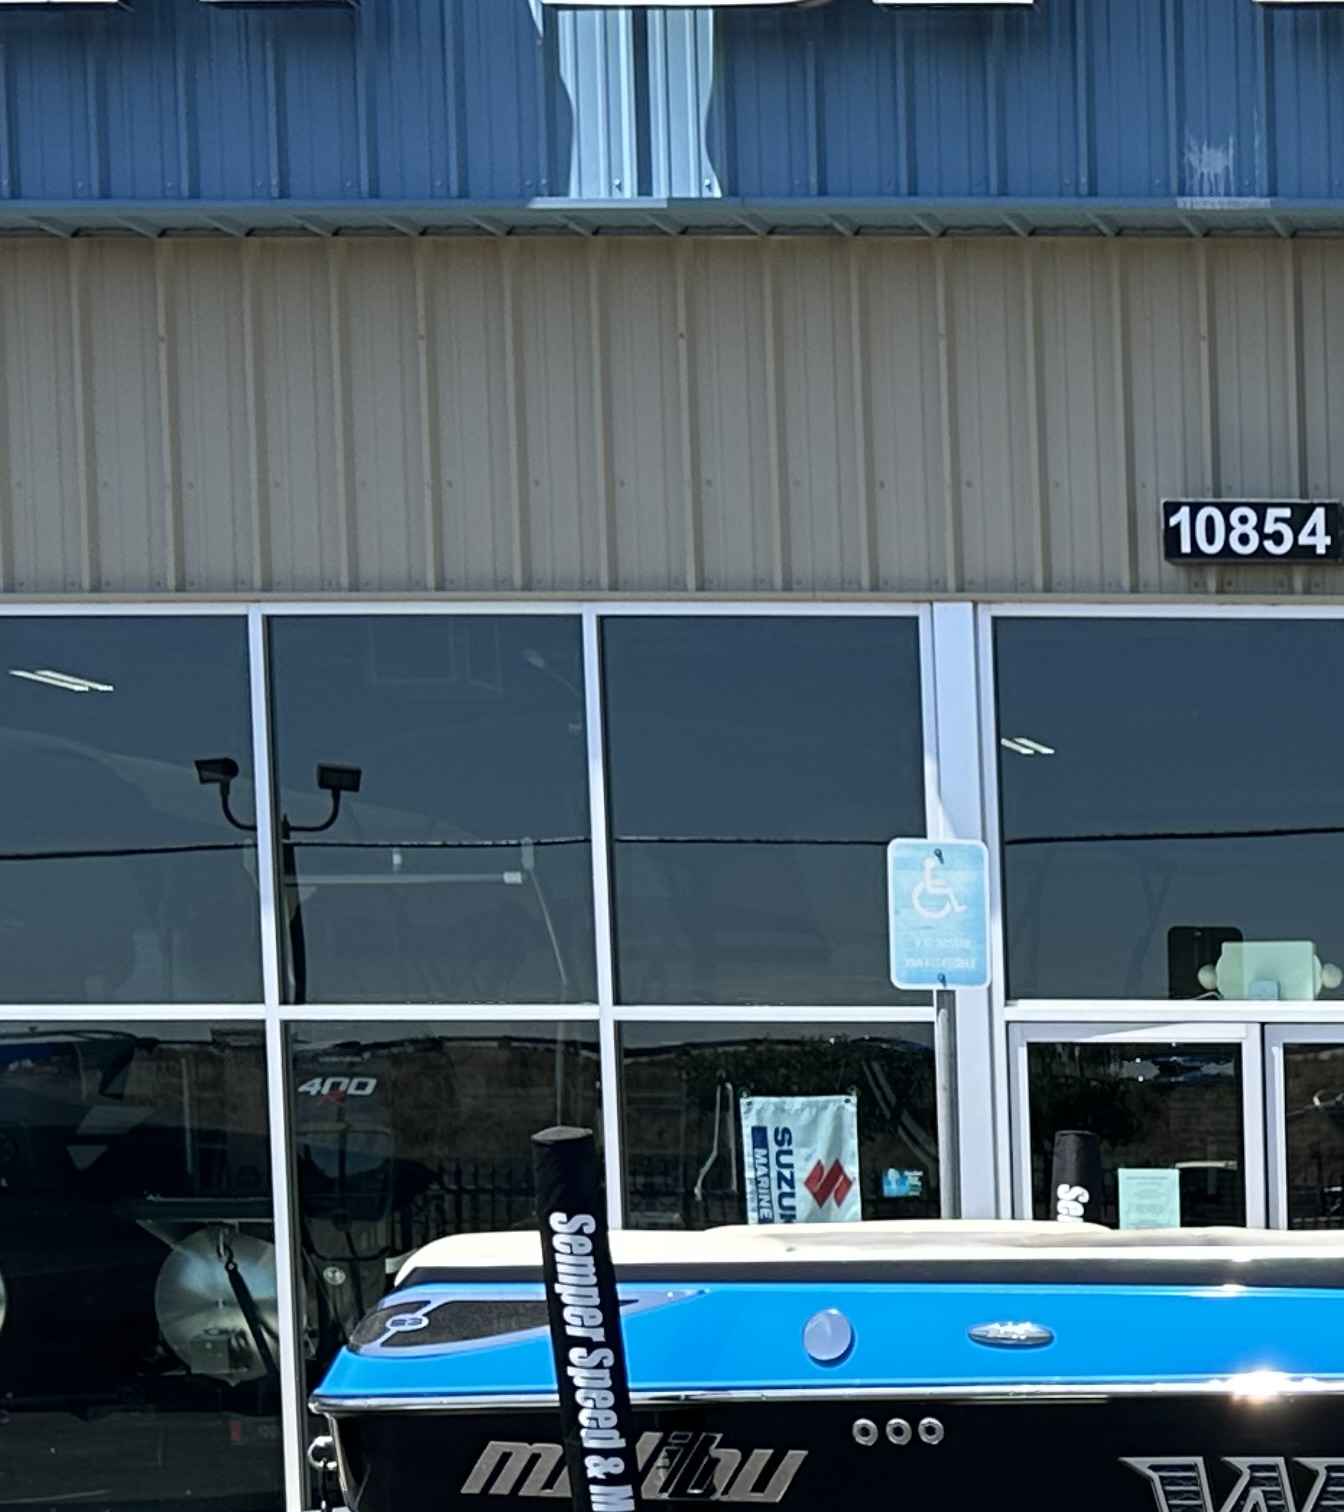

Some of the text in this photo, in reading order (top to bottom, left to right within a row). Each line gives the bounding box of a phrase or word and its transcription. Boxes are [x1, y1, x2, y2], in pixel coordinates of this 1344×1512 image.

[1168, 505, 1333, 555] 10854
[297, 1076, 377, 1096] 400
[753, 1148, 774, 1220] MARINE
[773, 1126, 798, 1222] SUZU
[548, 1211, 606, 1343] Semper
[567, 1345, 626, 1450] Speed
[459, 1432, 810, 1503] mlibu
[583, 1454, 626, 1481] &
